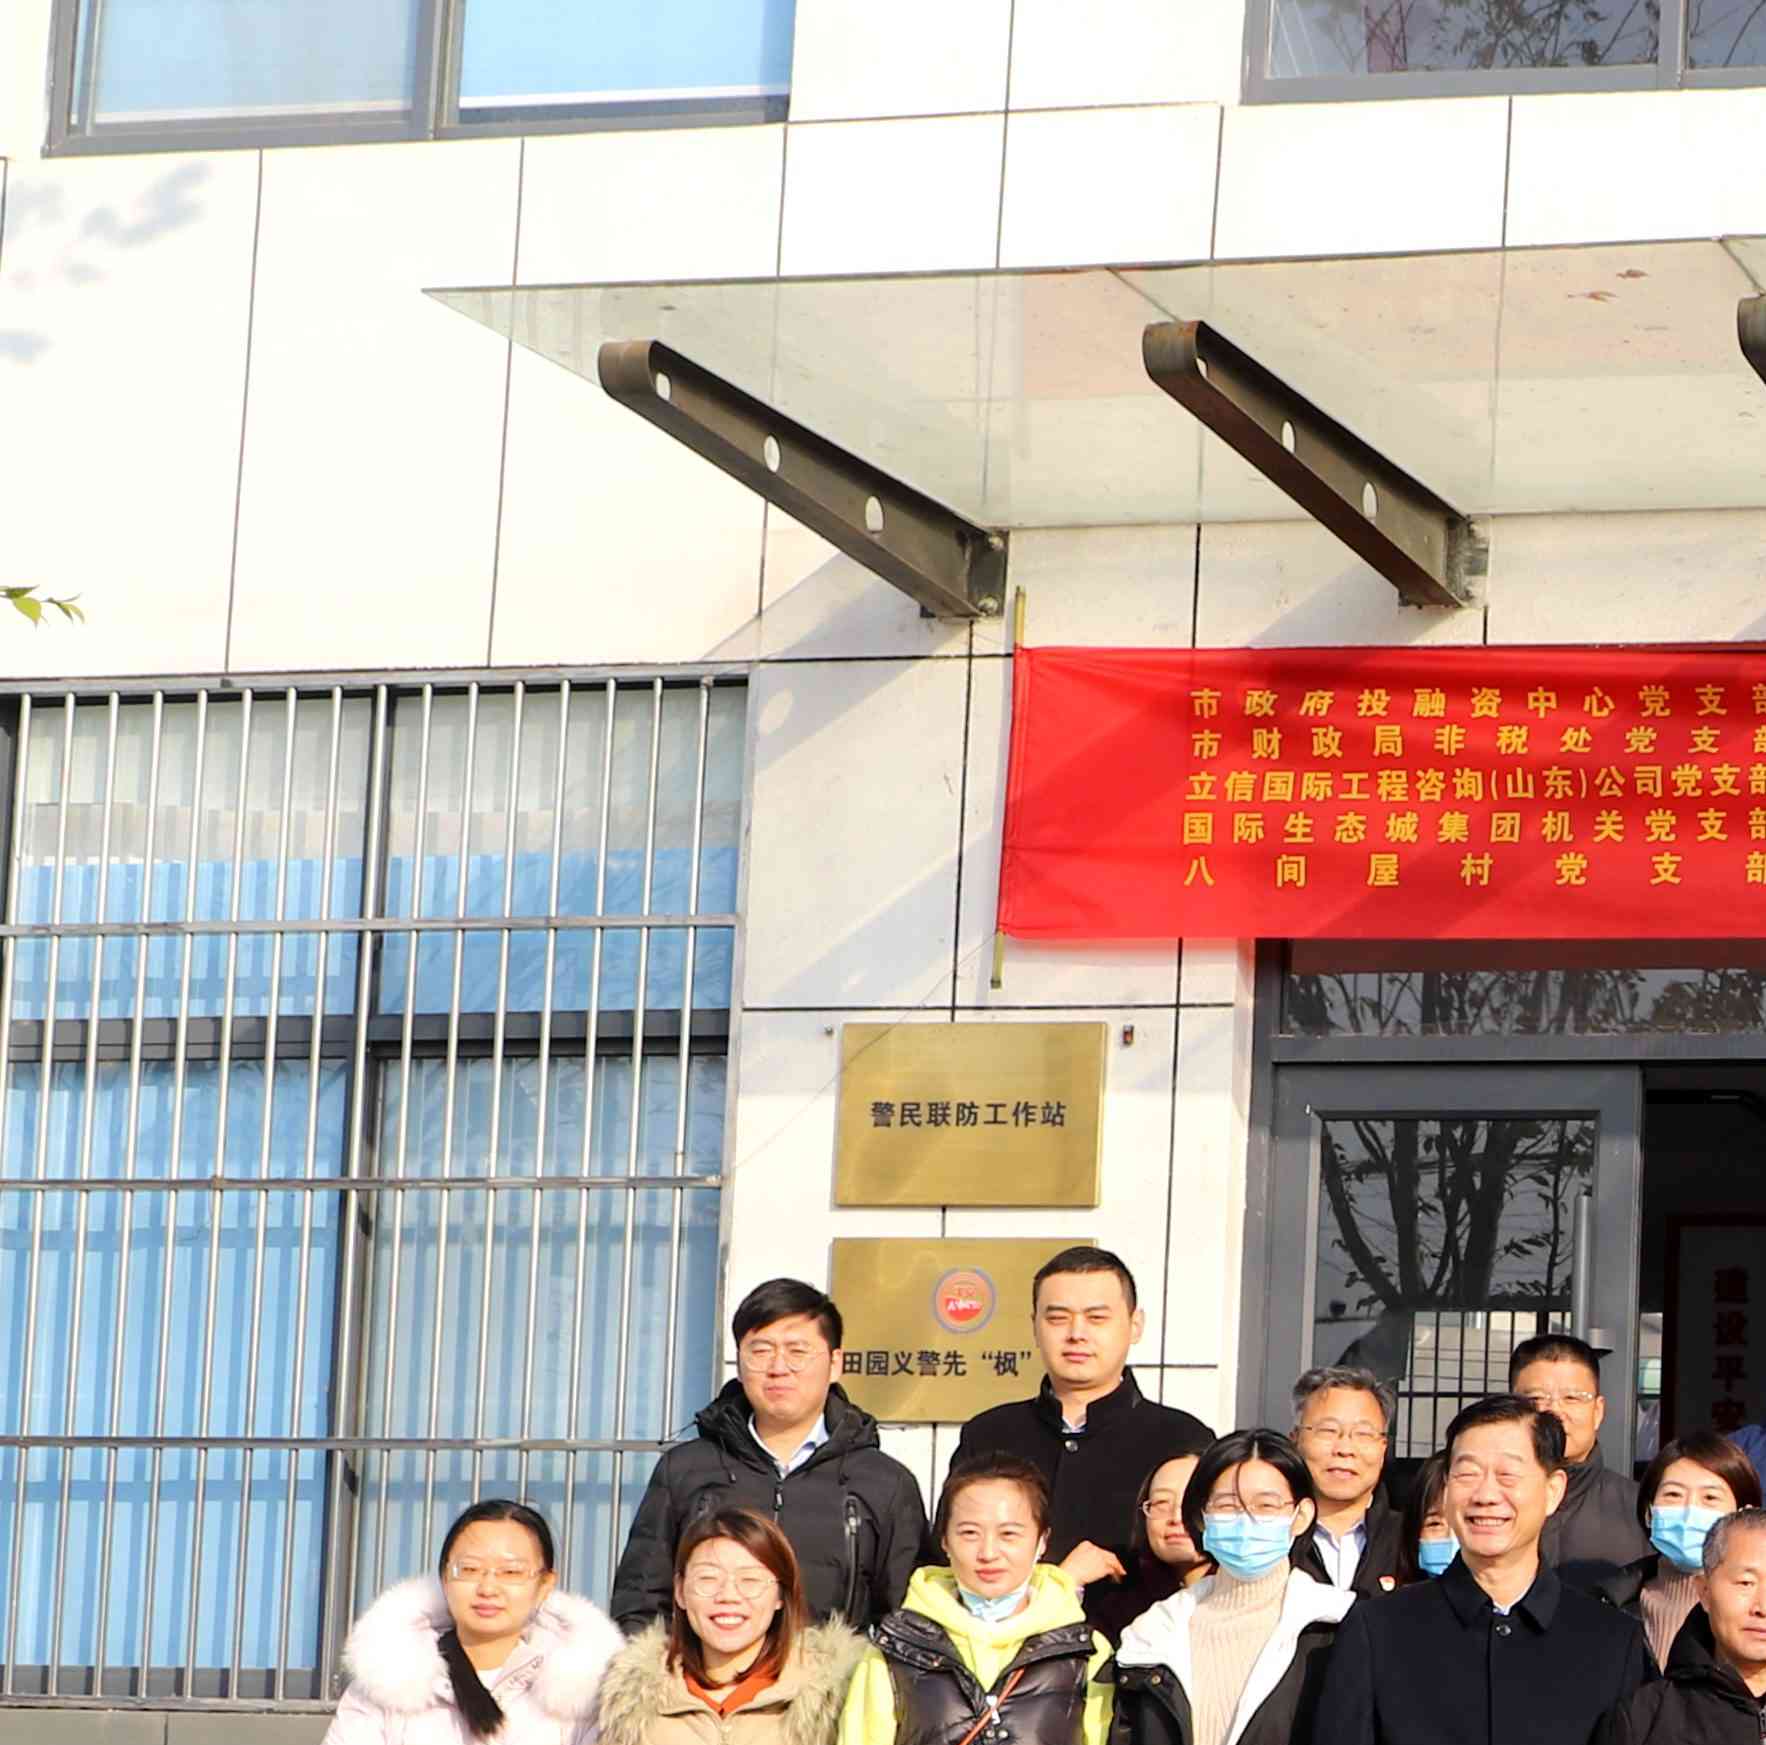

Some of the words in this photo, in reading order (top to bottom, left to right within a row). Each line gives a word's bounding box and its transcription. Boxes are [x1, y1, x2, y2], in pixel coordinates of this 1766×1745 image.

[870, 1101, 1067, 1128] 警民联防工作站
